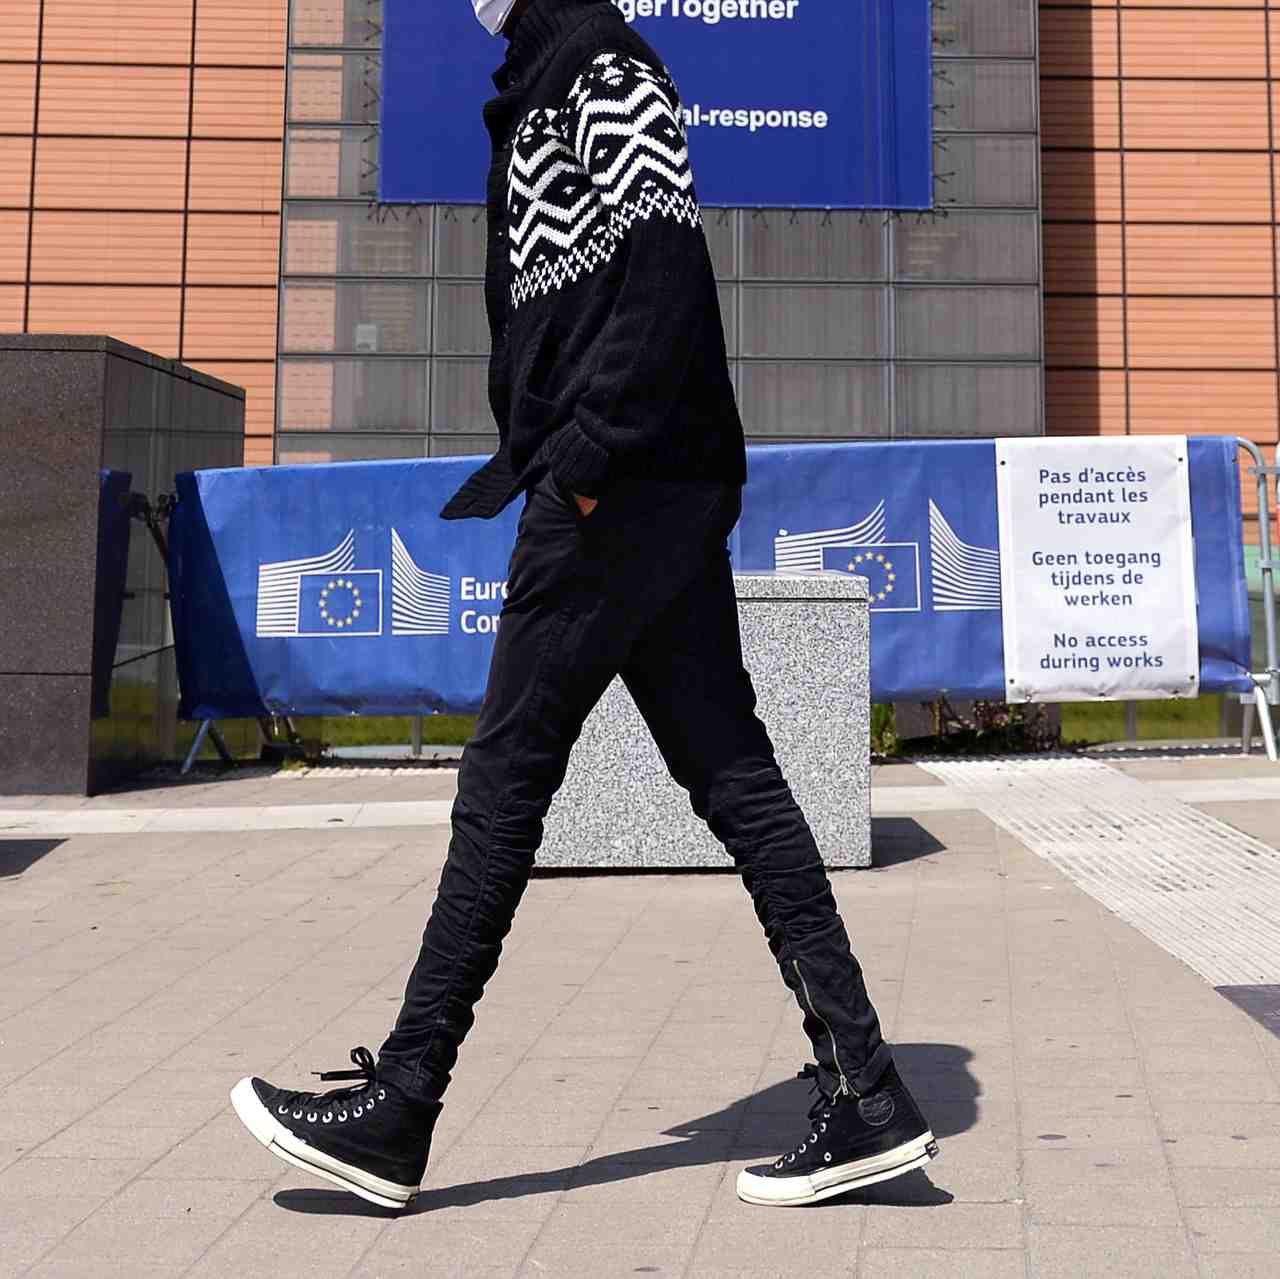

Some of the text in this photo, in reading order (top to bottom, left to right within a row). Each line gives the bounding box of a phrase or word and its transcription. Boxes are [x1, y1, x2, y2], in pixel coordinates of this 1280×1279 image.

[682, 103, 828, 132] al-response
[1039, 466, 1147, 484] Pas d'accès
[1039, 487, 1148, 508] pendant les
[1057, 510, 1131, 525] travaux
[1032, 551, 1161, 568] Geen toegang
[1050, 569, 1144, 590] tijdens de
[1064, 590, 1133, 606] werken
[1053, 633, 1148, 648] No access
[1040, 651, 1163, 672] during works
